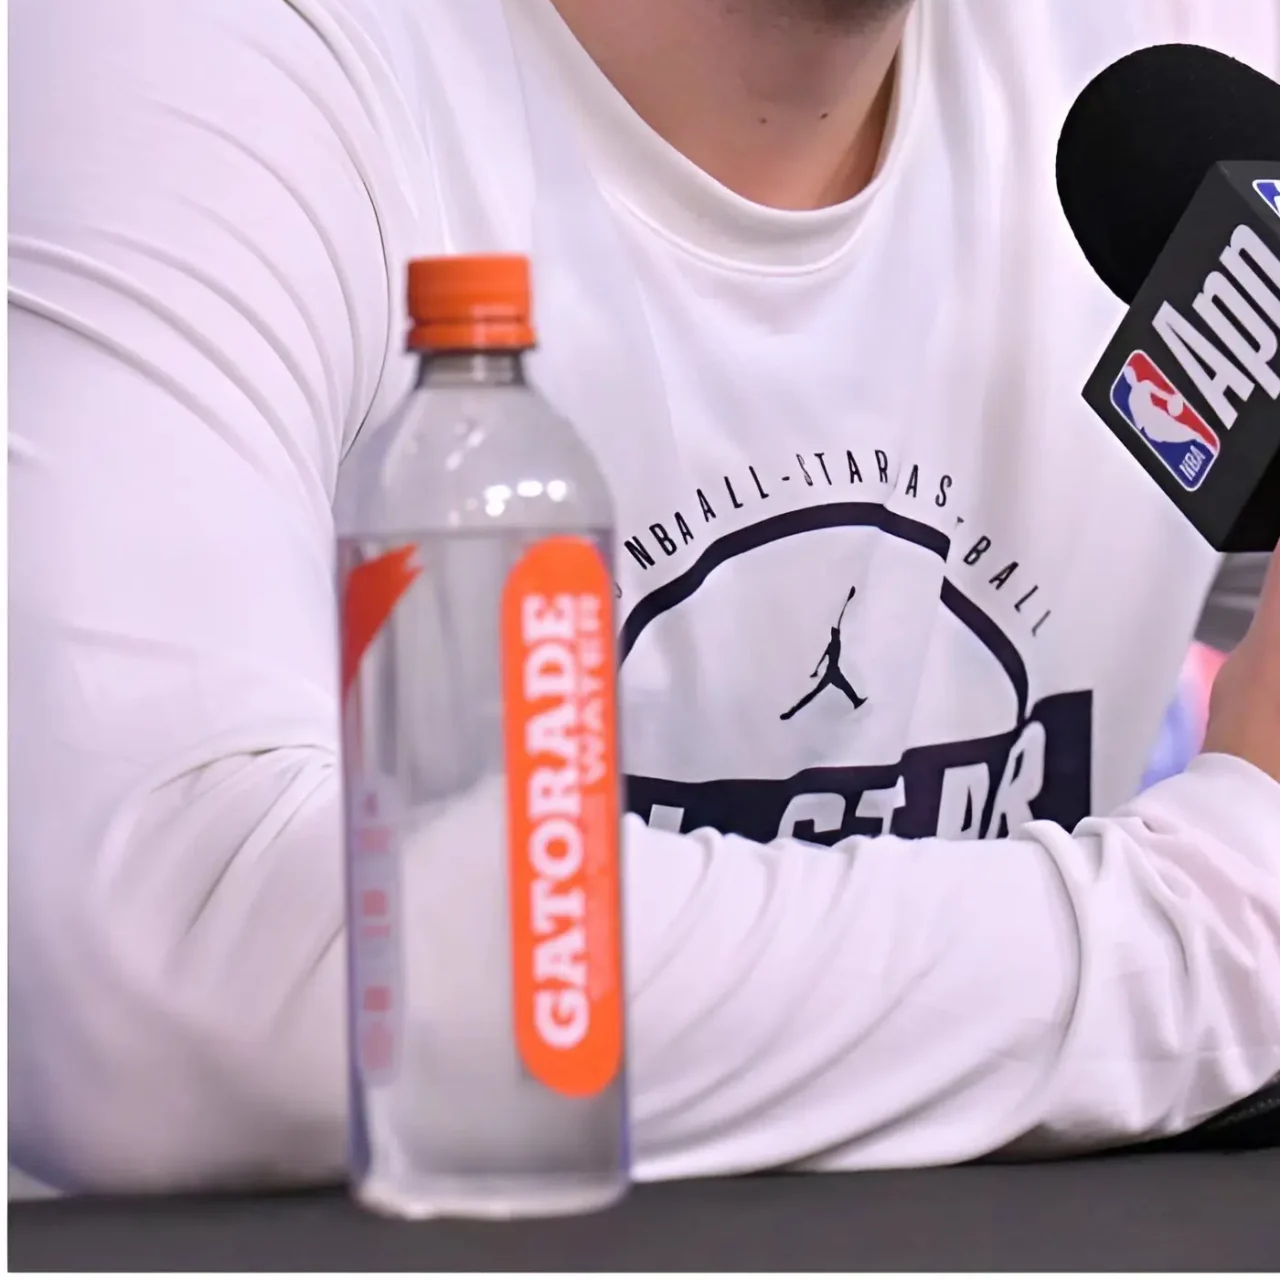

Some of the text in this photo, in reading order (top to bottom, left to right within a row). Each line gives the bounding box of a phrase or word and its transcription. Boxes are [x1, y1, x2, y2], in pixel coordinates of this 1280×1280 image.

[1179, 445, 1206, 481] NBA
[576, 592, 607, 787] WATER
[521, 592, 590, 1049] GATORADE
